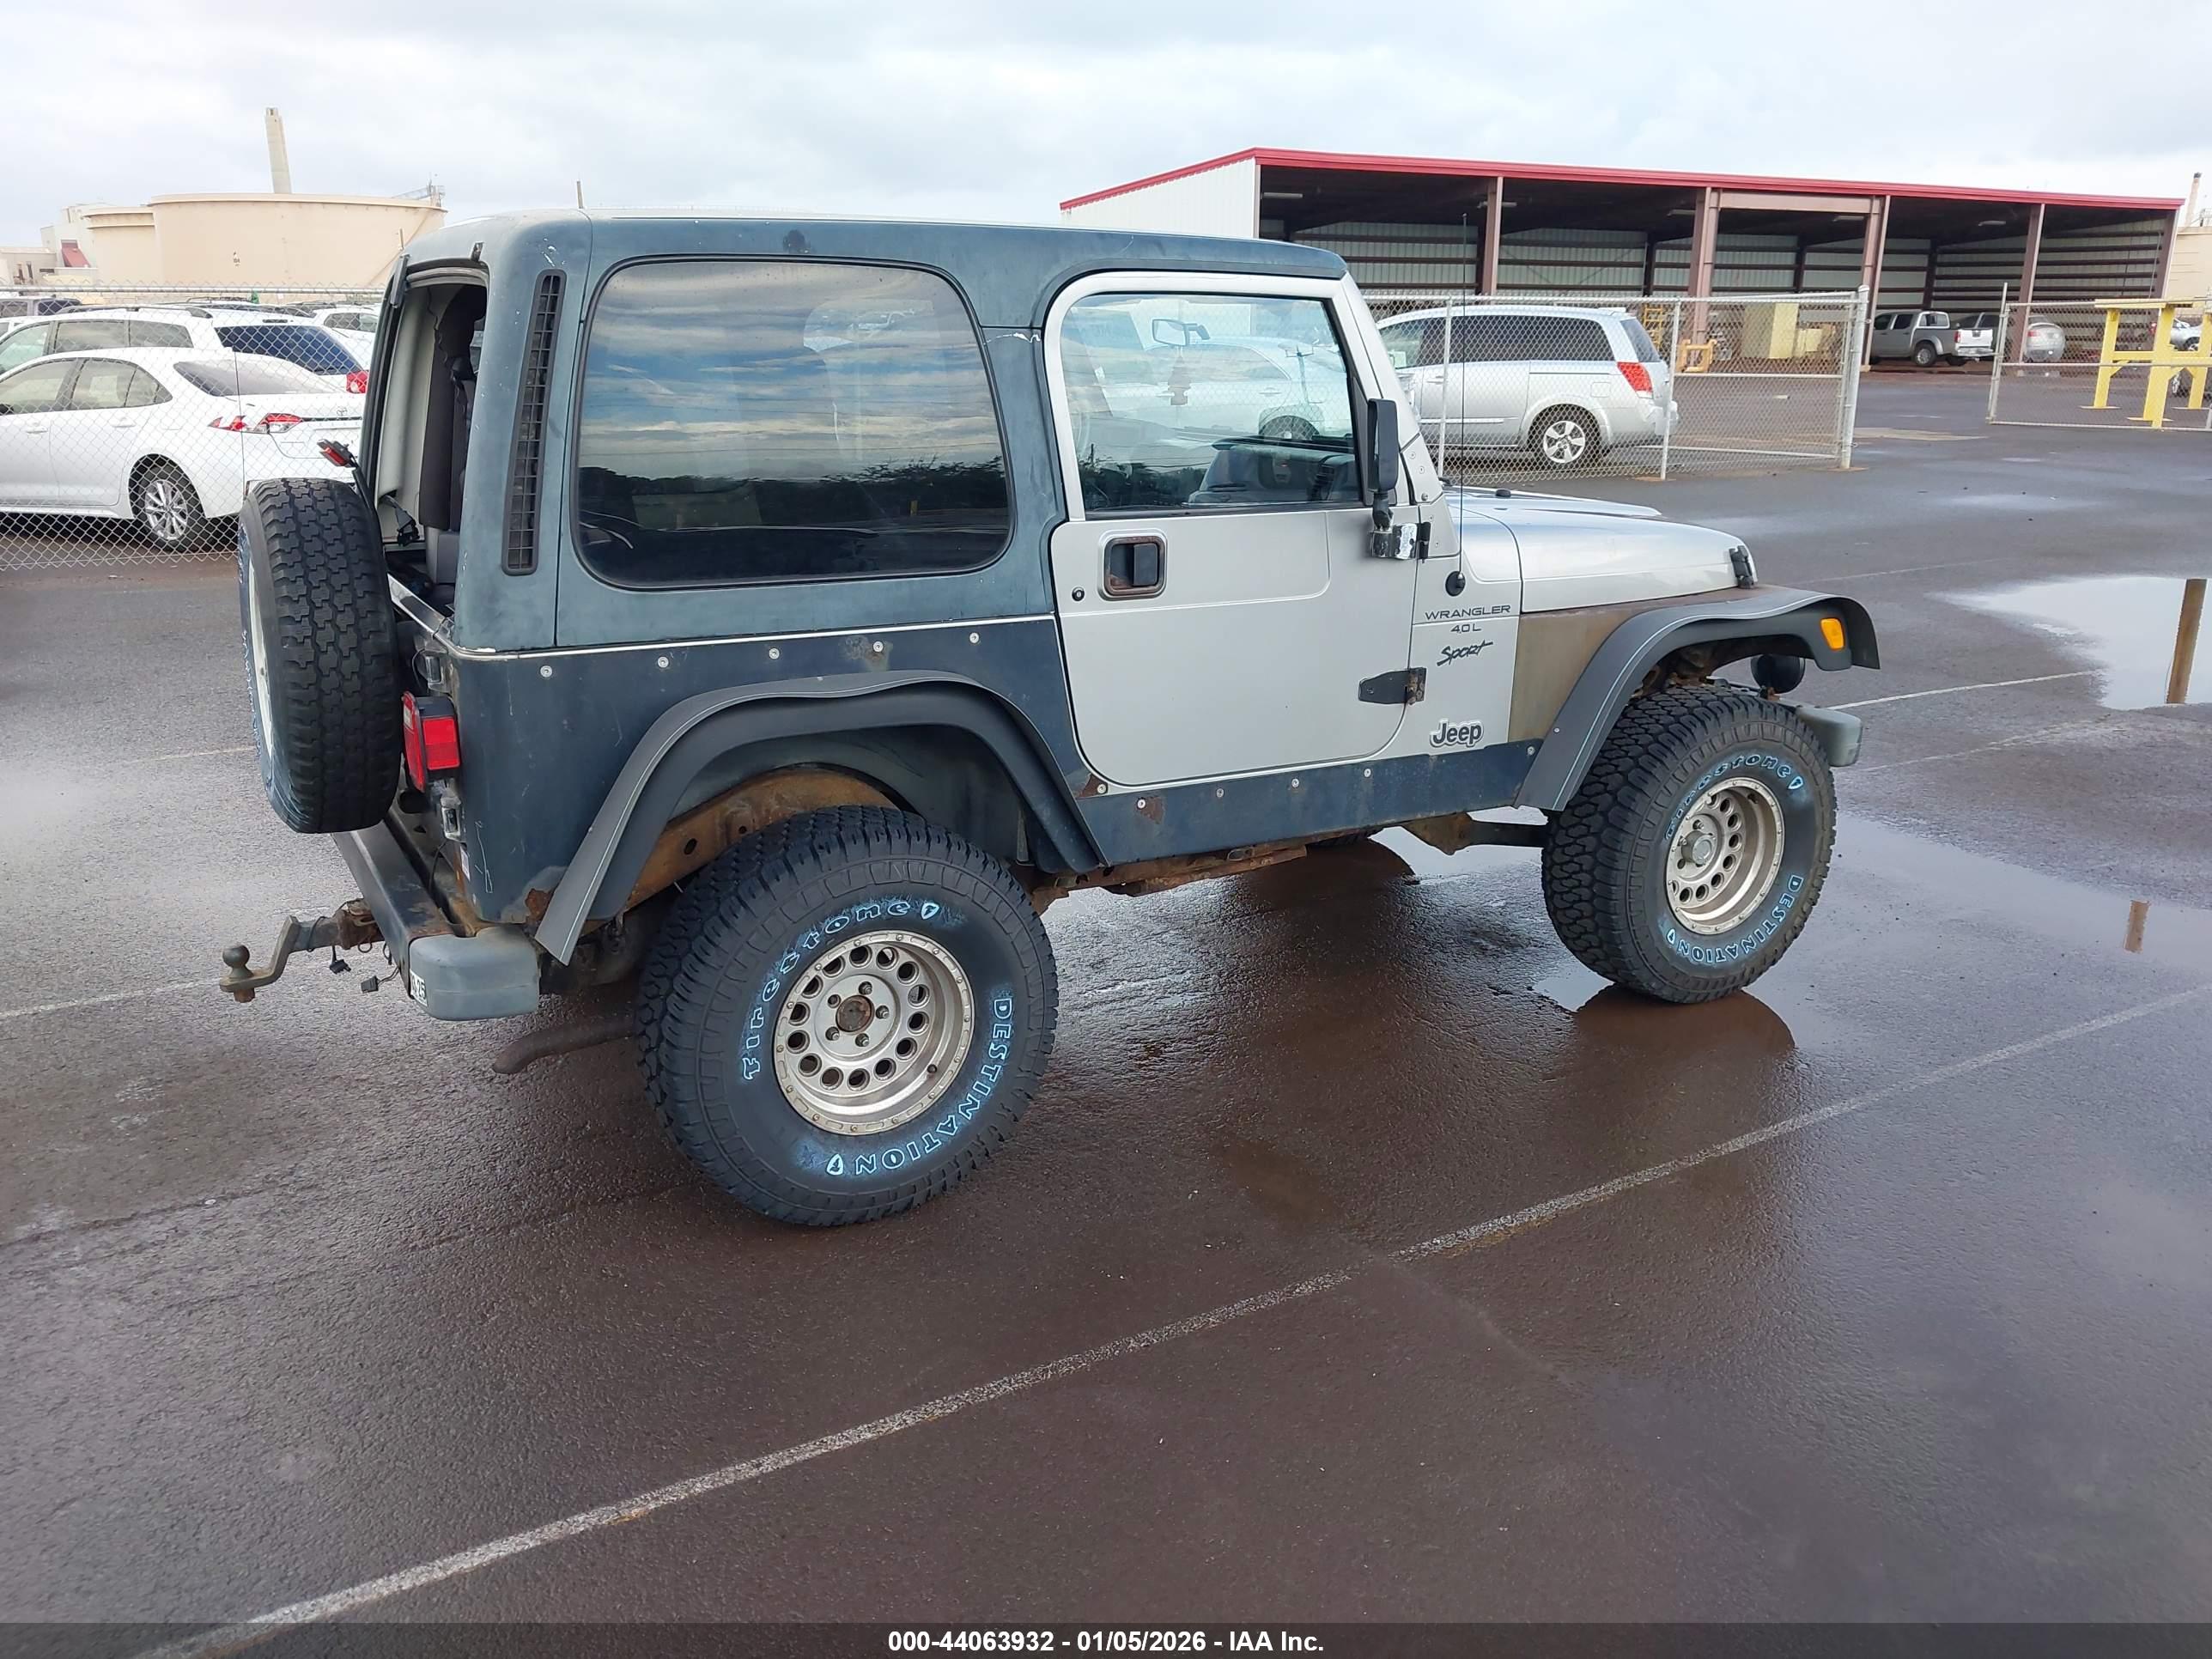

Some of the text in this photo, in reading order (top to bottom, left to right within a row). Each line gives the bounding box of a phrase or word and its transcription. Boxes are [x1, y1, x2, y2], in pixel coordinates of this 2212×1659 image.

[1425, 605, 1511, 621] WRANGLER
[1437, 640, 1493, 666] Sport
[1431, 721, 1483, 746] Jeep
[1678, 874, 1804, 963] DESTINATION
[743, 901, 911, 1080] Firestone
[855, 998, 1012, 1176] DESTINATION
